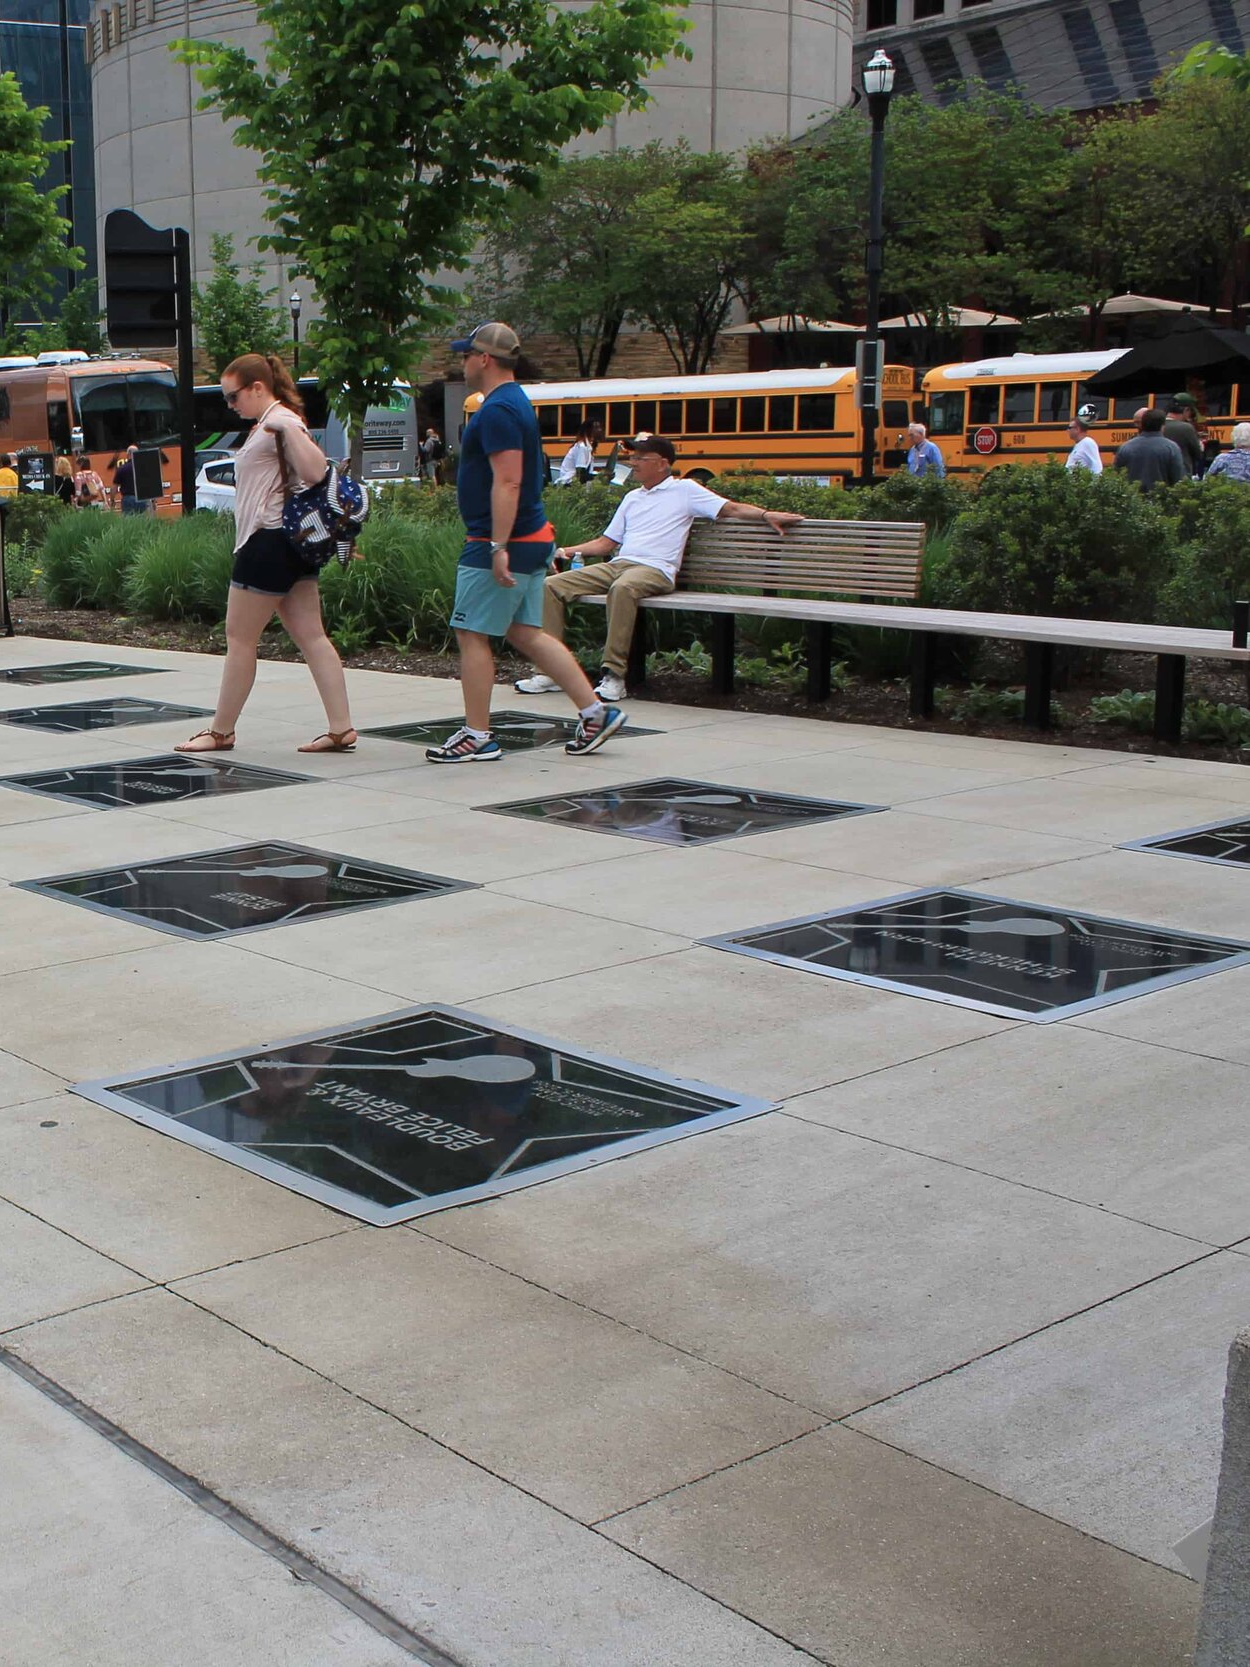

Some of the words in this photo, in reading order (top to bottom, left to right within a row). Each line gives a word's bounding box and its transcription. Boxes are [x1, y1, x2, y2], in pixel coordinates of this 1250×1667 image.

[977, 435, 994, 446] STOP
[940, 951, 1064, 979] KENNETH
[299, 1086, 331, 1097] &
[311, 1078, 413, 1114] BRYANT
[319, 1094, 476, 1152] BOUDLEAUX
[401, 1111, 497, 1145] FELICE
